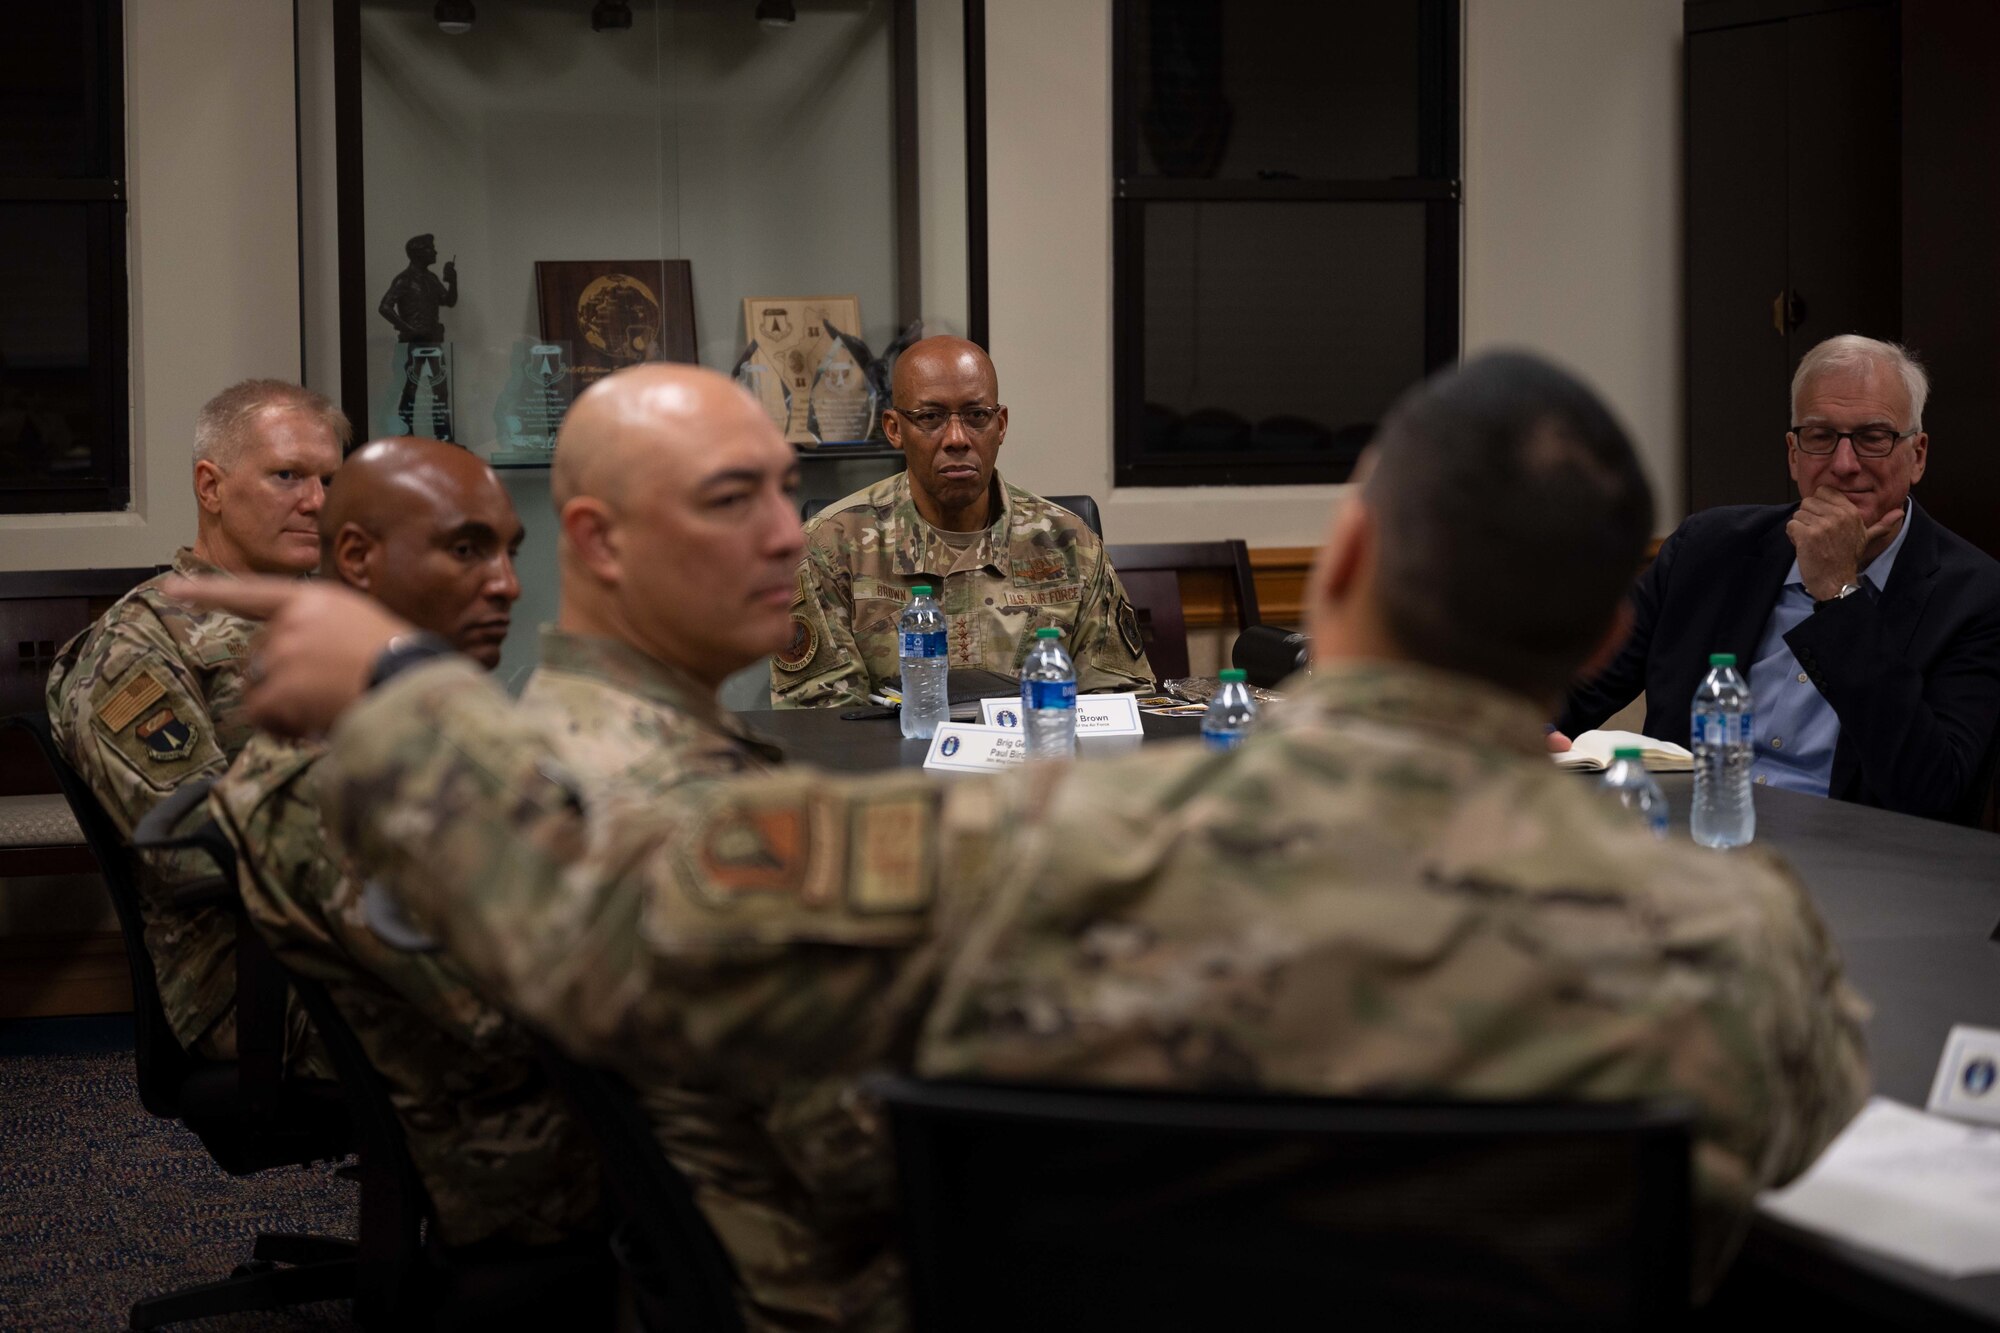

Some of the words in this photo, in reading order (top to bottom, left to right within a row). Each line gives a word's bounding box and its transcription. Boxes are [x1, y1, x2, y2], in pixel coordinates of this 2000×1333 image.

[877, 585, 906, 601] BROWN
[1010, 593, 1028, 605] U.S.
[1030, 591, 1047, 604] AIR
[1049, 586, 1078, 603] FORCE
[789, 658, 807, 670] STATES
[805, 651, 814, 661] AIR
[1079, 714, 1109, 723] Brown
[996, 738, 1013, 749] Brig
[1014, 739, 1026, 748] Ge
[990, 748, 1008, 758] Paul
